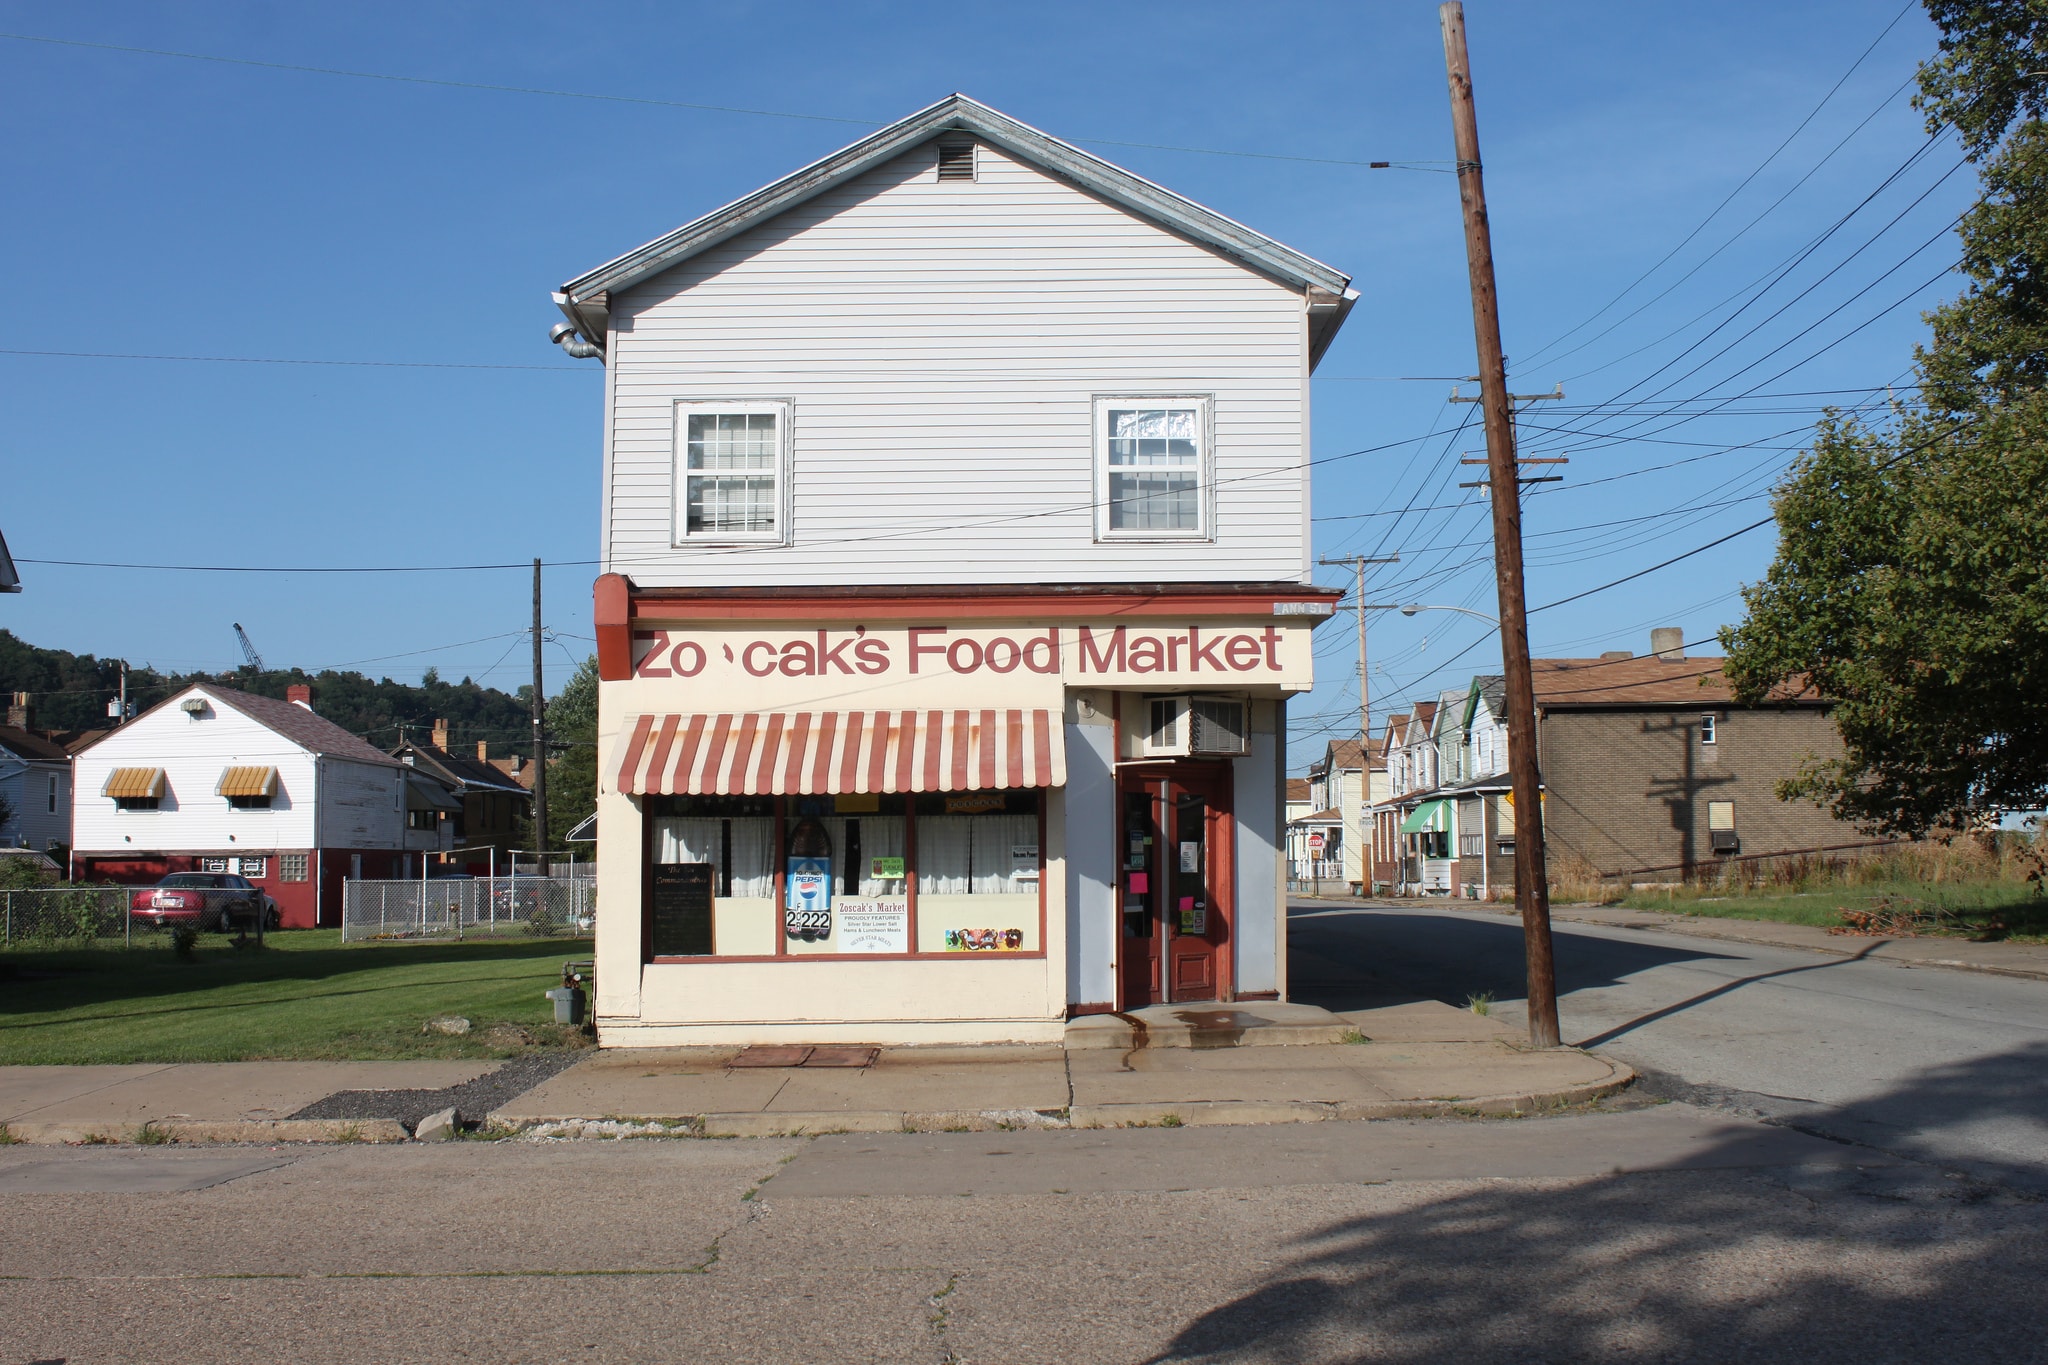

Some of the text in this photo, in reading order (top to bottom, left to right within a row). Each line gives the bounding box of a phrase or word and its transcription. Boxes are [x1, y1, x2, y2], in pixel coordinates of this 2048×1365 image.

[1282, 603, 1305, 614] ANN
[908, 626, 1060, 675] Food
[1078, 625, 1283, 674] Market
[839, 902, 905, 913] Zoscak's Market
[787, 911, 796, 928] 2
